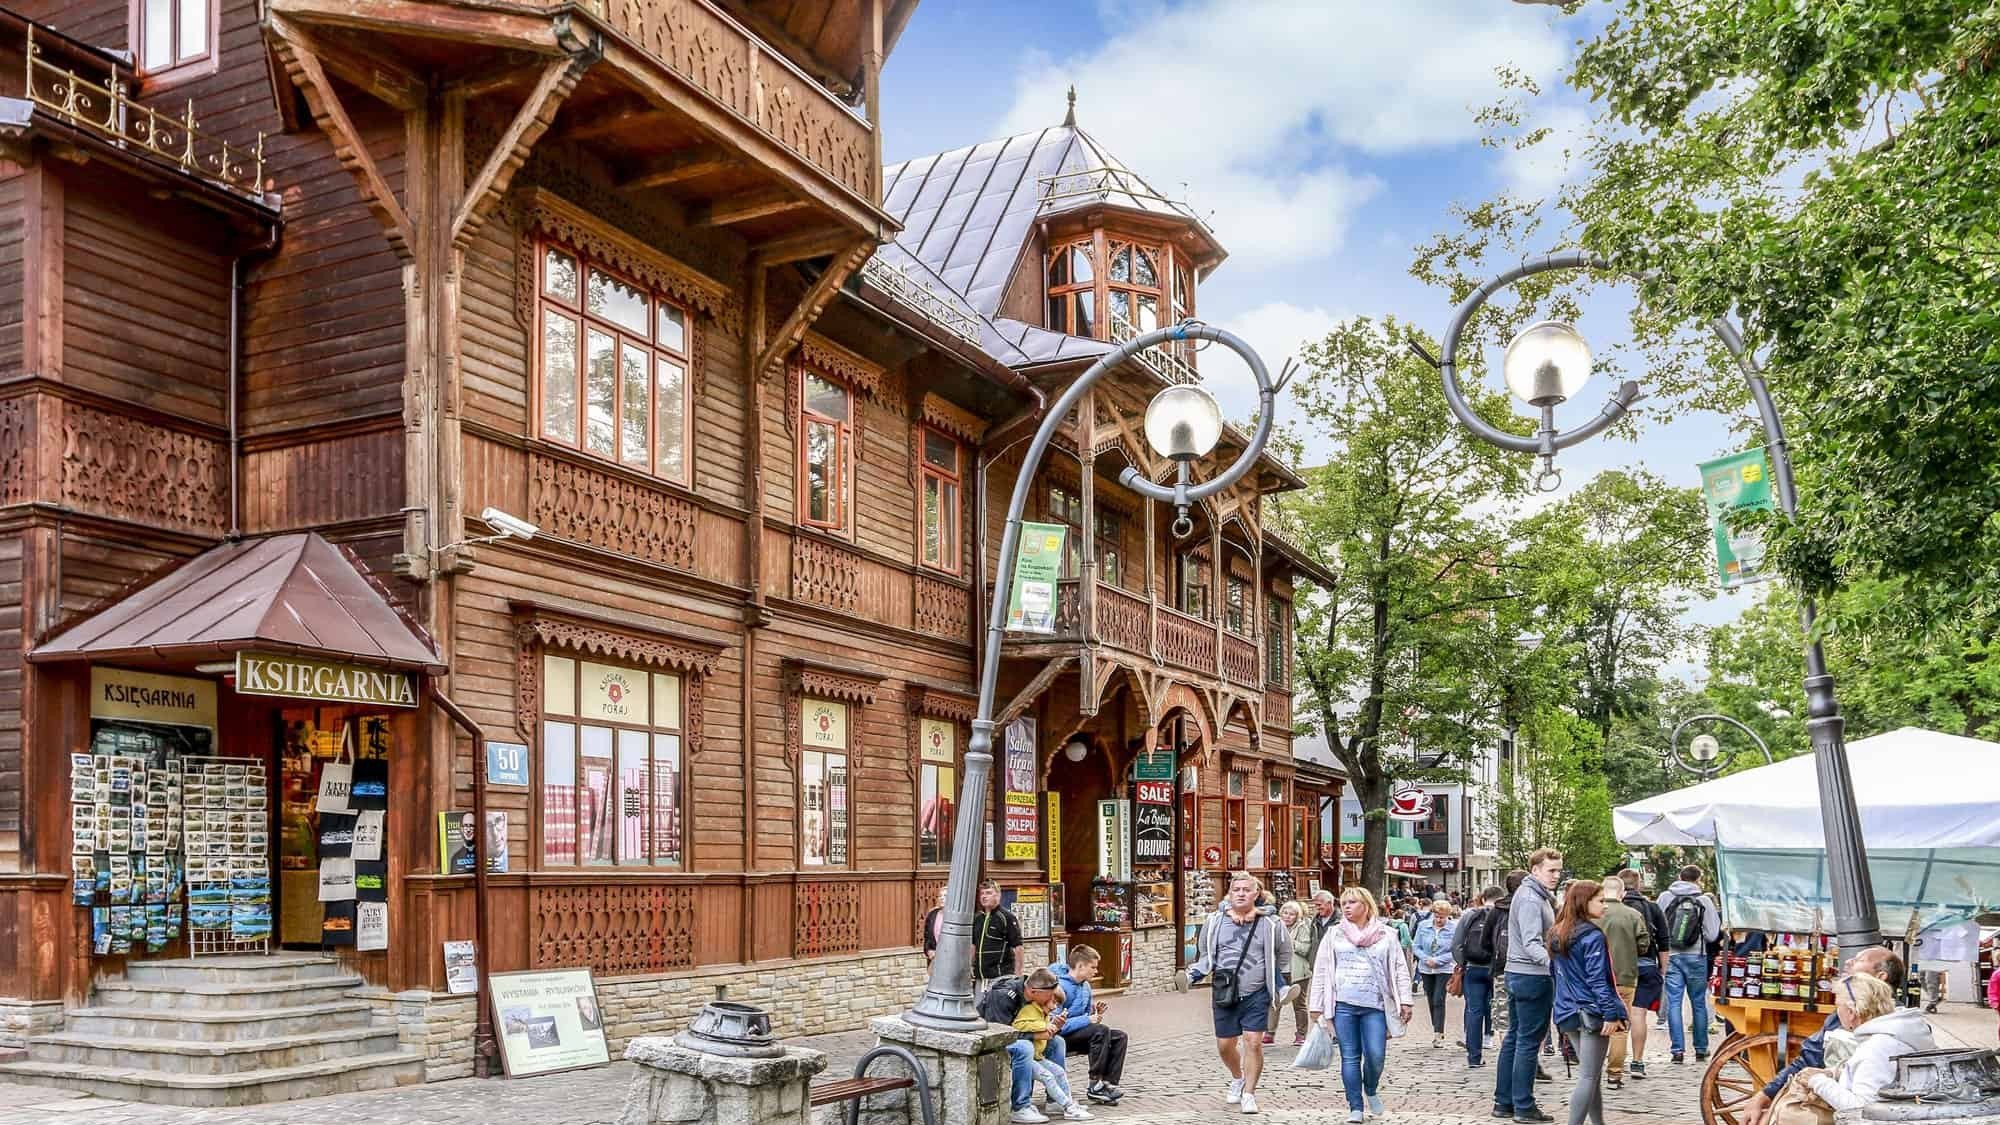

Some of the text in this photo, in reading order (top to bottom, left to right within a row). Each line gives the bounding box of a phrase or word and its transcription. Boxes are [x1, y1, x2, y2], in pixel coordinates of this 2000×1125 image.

[245, 659, 414, 704] KSIĘGARNIA
[104, 683, 195, 709] KSIĘGARNIA
[1008, 735, 1033, 754] Salon
[498, 747, 519, 771] 50
[1140, 784, 1170, 802] SALE
[1007, 818, 1035, 832] SKLEPU
[1136, 807, 1150, 825] La
[1136, 838, 1170, 856] OBUWIE
